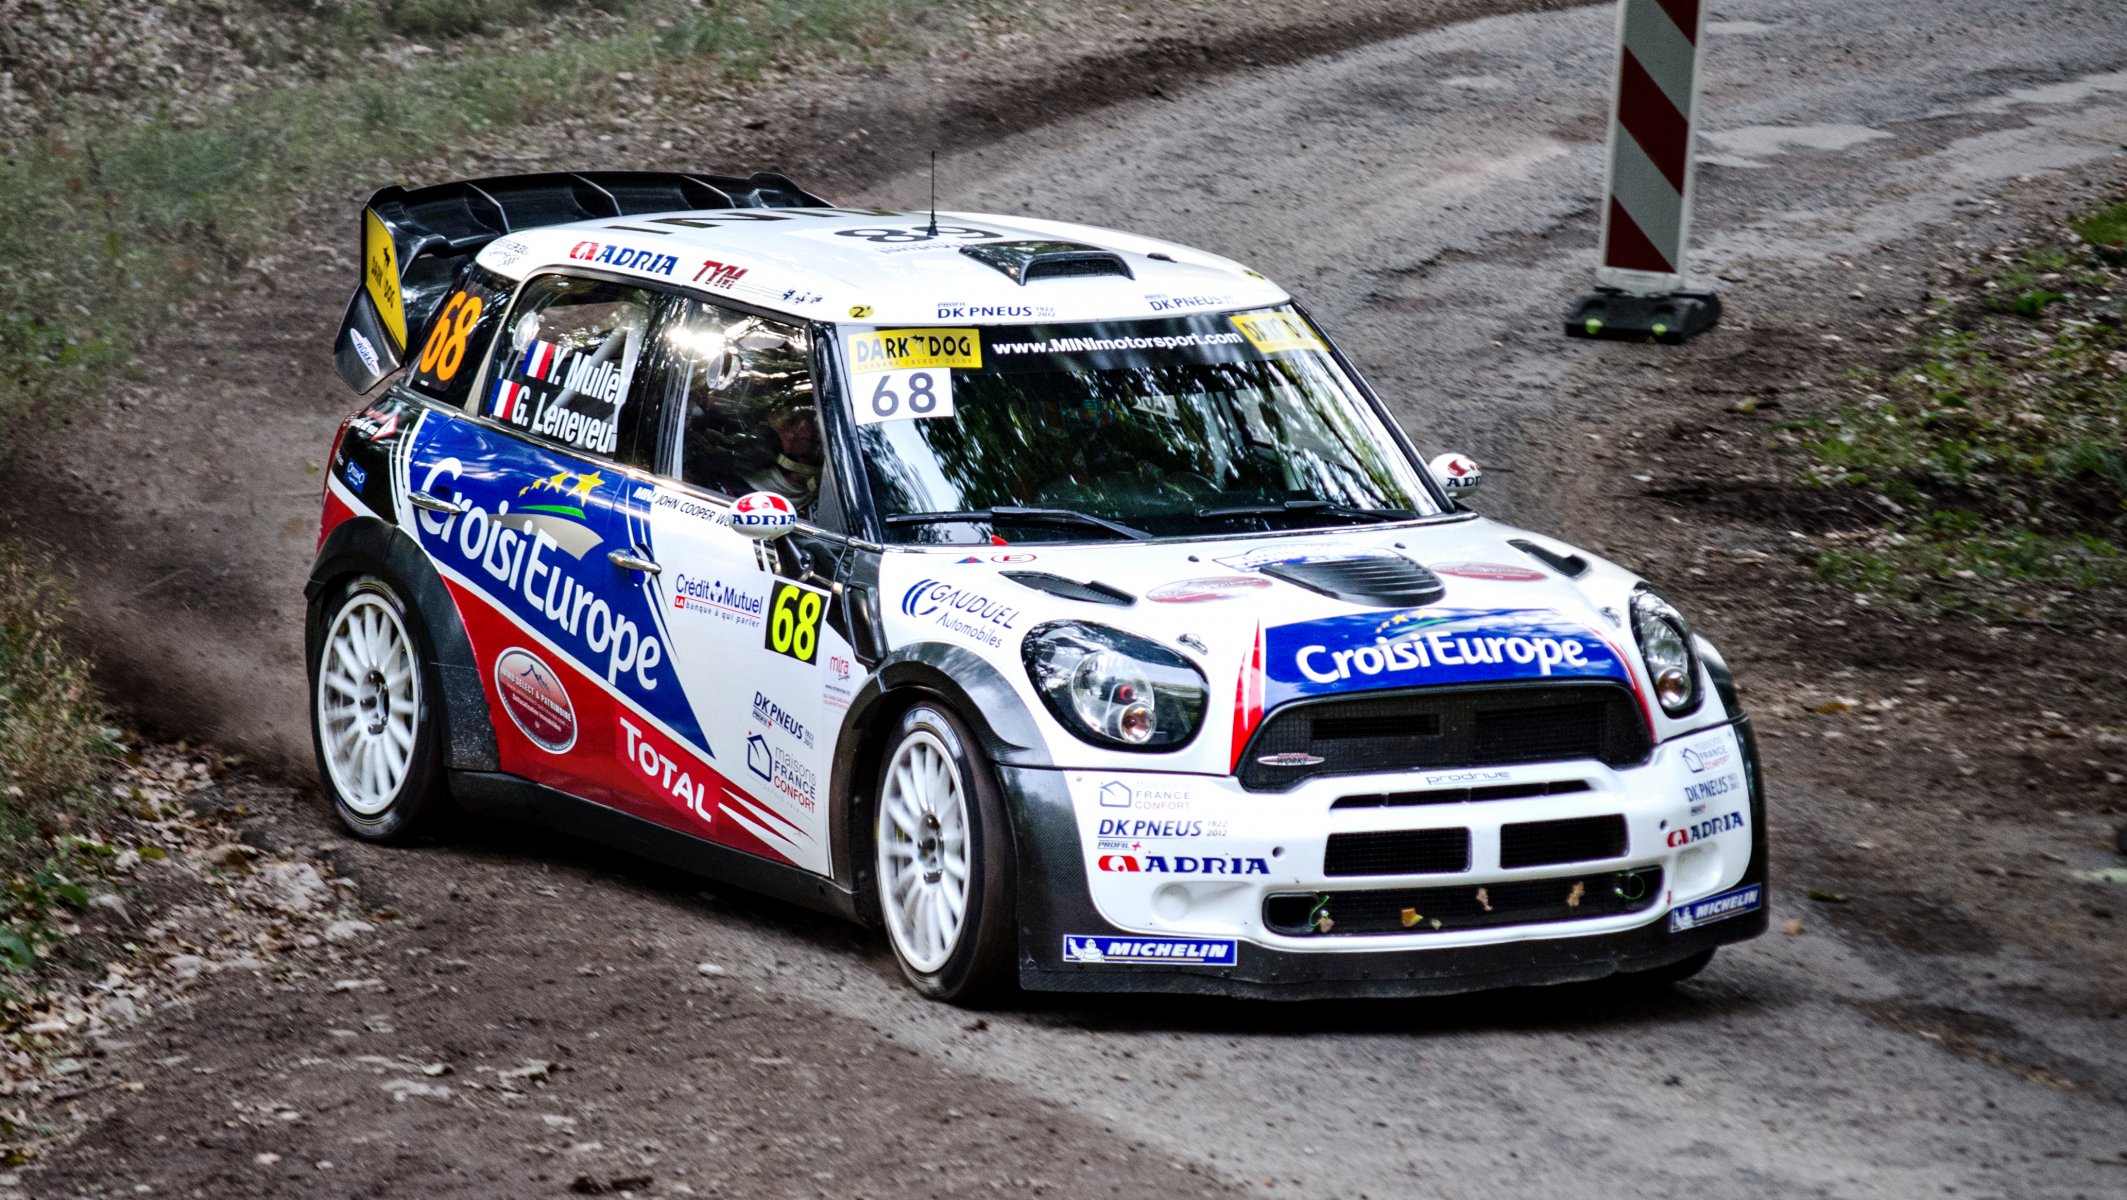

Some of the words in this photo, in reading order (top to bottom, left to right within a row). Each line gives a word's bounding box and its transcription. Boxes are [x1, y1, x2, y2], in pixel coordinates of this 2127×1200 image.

[596, 245, 679, 276] ADRIA
[937, 308, 964, 319] DK
[969, 306, 1032, 317] PNEUS
[1150, 300, 1175, 311] DK
[1175, 295, 1223, 308] PNEUS
[420, 290, 483, 381] 68
[856, 337, 909, 365] DARK
[928, 335, 972, 357] DOG
[992, 332, 1244, 355] www.MINImotorsport.com
[547, 345, 570, 385] Y.
[905, 357, 939, 365] ENERGY
[944, 357, 973, 365] DRINK
[872, 372, 937, 417] 68
[511, 385, 531, 427] G.
[532, 392, 617, 454] Leneveu
[655, 495, 681, 510] JOHN
[680, 501, 716, 521] COOPER
[732, 513, 796, 526] ADRIA
[419, 457, 662, 691] CroisiEurope
[676, 573, 709, 600] Crédit
[723, 586, 764, 615] Mutuel
[930, 584, 1021, 630] GAUDUEL
[685, 600, 712, 616] banque
[721, 611, 734, 621] qui
[735, 615, 761, 628] parler
[772, 584, 821, 661] 68
[936, 611, 1004, 648] Automobiles
[829, 655, 849, 676] mira
[1295, 630, 1589, 684] CroisiEurope
[754, 690, 771, 714] DK
[769, 703, 804, 740] PNEUS
[775, 746, 817, 787] maisons
[1700, 745, 1728, 760] FRANCE
[619, 716, 712, 824] TOTAL
[774, 761, 816, 800] FRANCE
[774, 775, 816, 814] CONFORT
[1136, 790, 1191, 800] FRANCE
[1685, 785, 1702, 803] DK
[1698, 776, 1729, 800] PNEUS
[1135, 800, 1190, 810] CONFORT
[1098, 819, 1131, 836] DK
[1132, 820, 1202, 837] PNEUS
[1206, 829, 1228, 837] 2012
[1207, 820, 1228, 828] 1922
[1690, 811, 1745, 842] ADRIA
[1097, 840, 1130, 849] PROFIL
[1145, 855, 1270, 875] ADRIA
[1696, 889, 1759, 919] MICHELIN
[1107, 942, 1229, 958] MICHELIN
